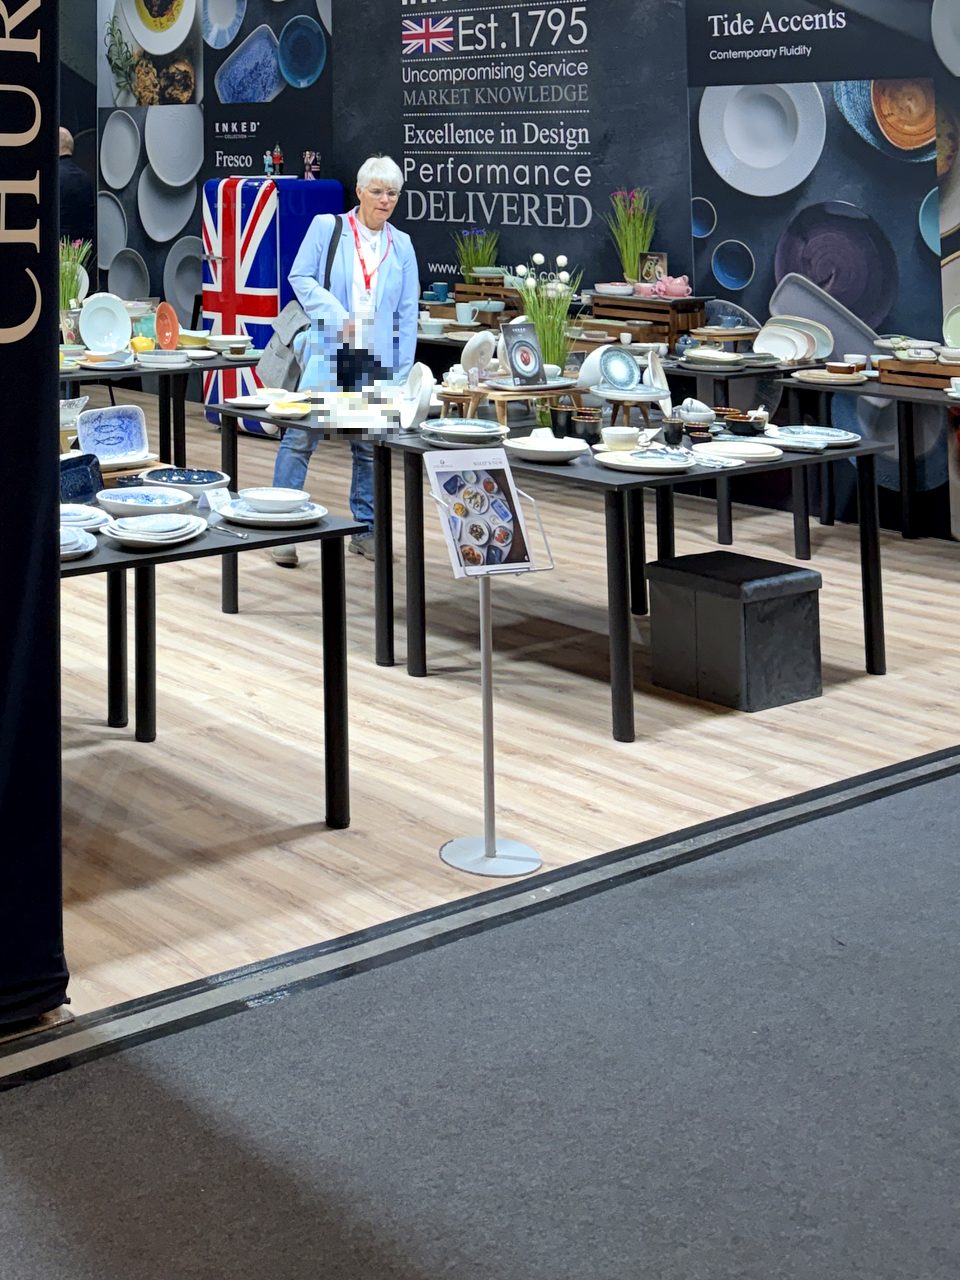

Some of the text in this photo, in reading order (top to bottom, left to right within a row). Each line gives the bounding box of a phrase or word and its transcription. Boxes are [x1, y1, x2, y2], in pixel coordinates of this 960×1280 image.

[708, 8, 847, 37] Tide Accents
[709, 44, 813, 61] Contemporary Fluidity
[402, 58, 589, 85] Uncompromising Service
[402, 83, 589, 106] MARKET KNOWLEDGE
[403, 121, 591, 151] Excellence in Design
[215, 150, 253, 168] Fresco
[403, 157, 592, 187] Performance
[405, 189, 593, 229] DELIVERED
